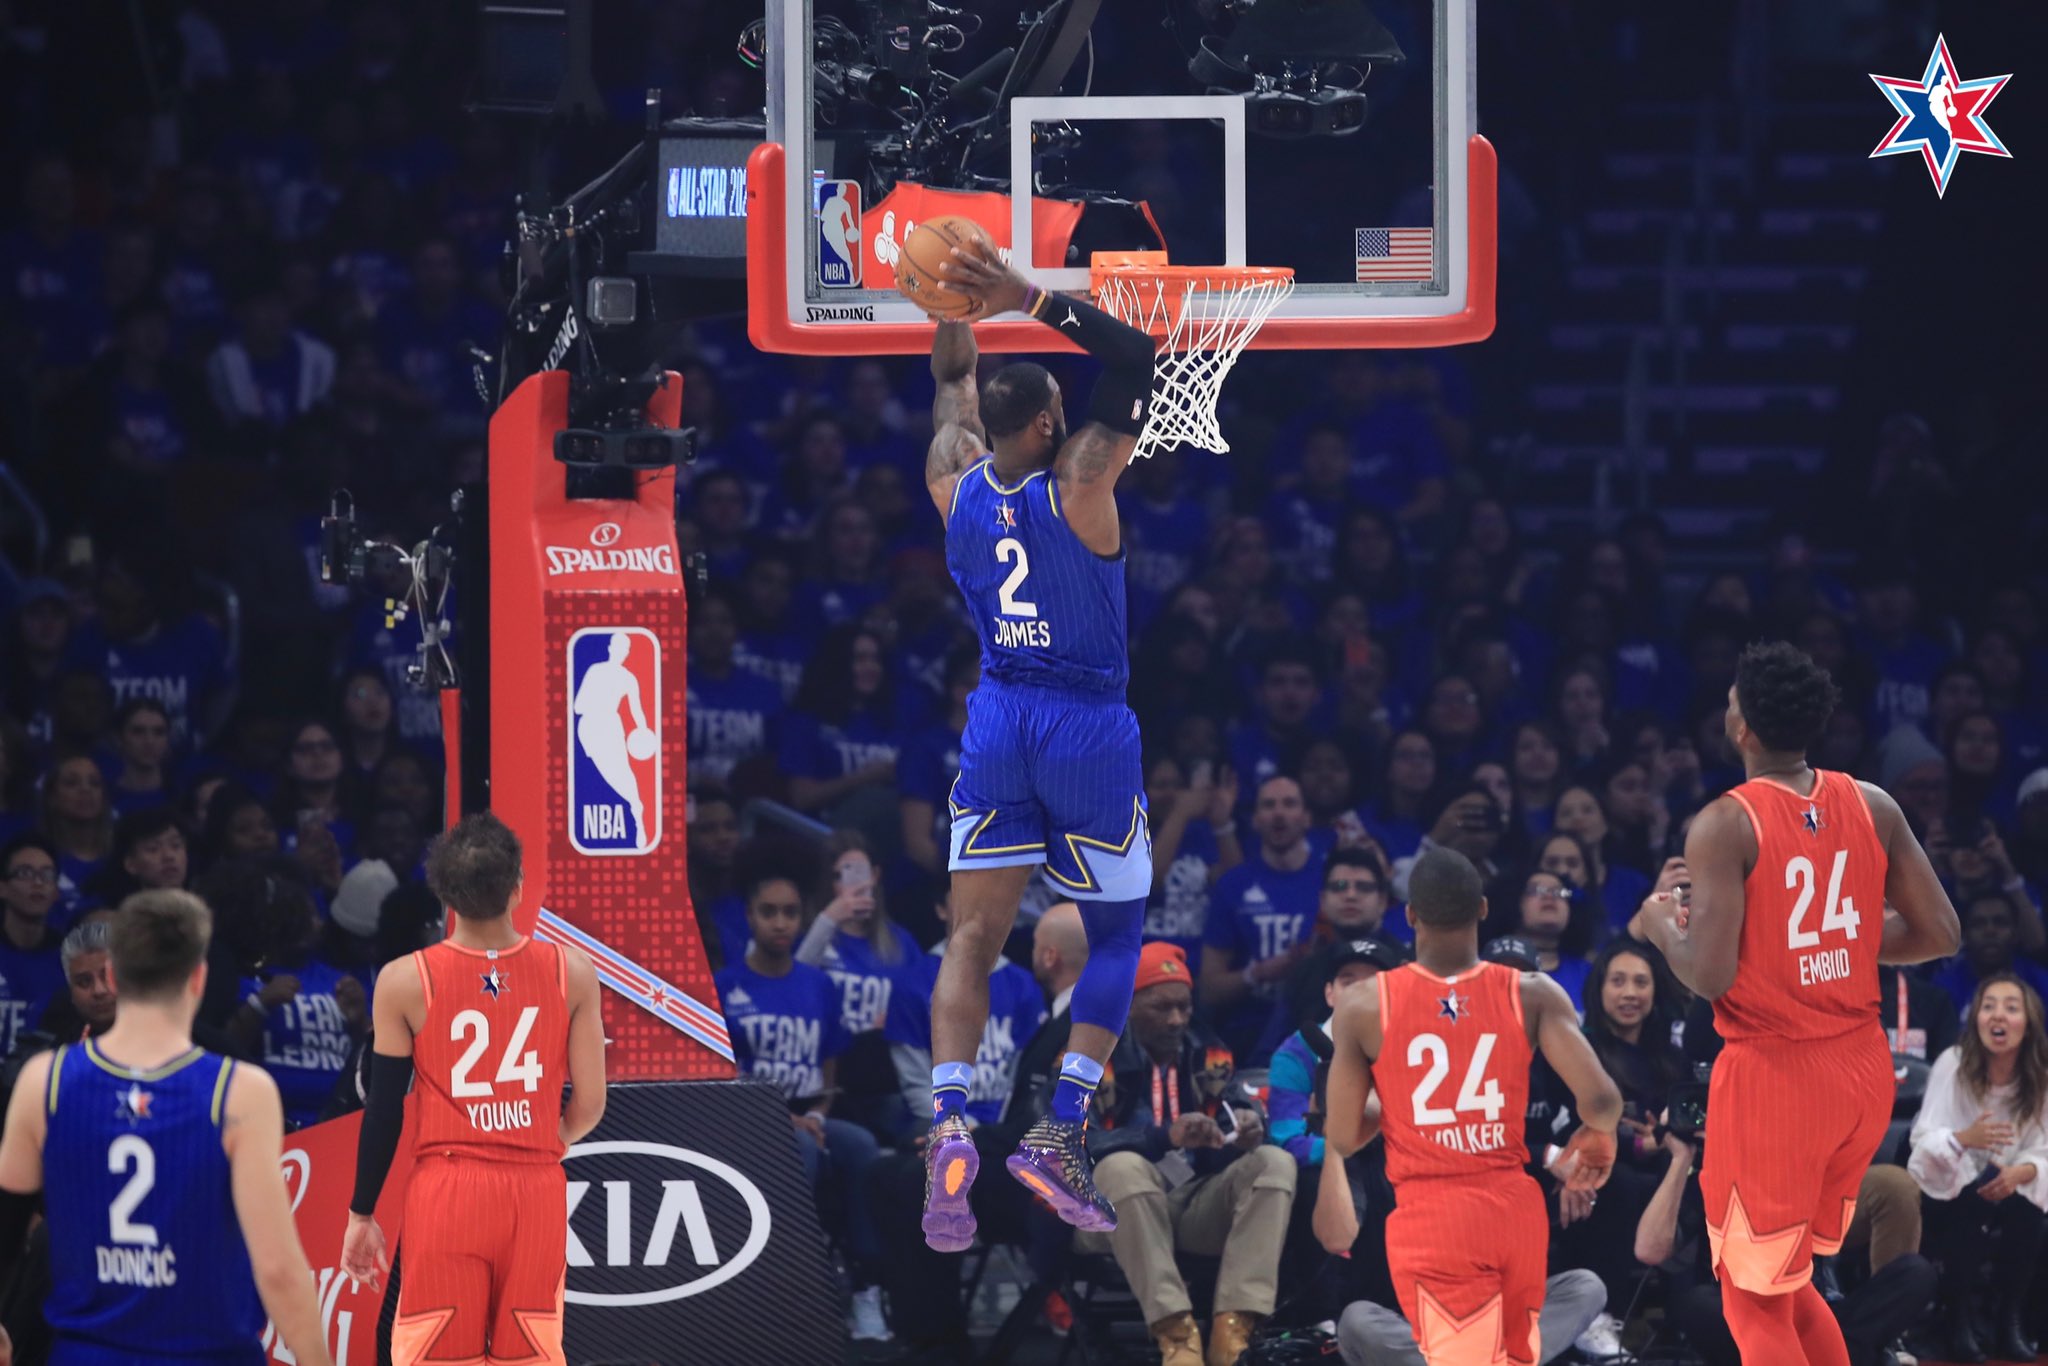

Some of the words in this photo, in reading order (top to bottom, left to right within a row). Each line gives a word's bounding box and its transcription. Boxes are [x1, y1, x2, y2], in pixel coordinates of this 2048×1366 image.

[825, 263, 846, 281] NBA
[806, 306, 875, 322] SPALDING
[545, 544, 677, 576] SPALDING
[995, 537, 1038, 617] 2
[993, 616, 1051, 648] JAMES
[583, 804, 627, 840] NBA
[1785, 849, 1861, 950] 24
[1799, 947, 1850, 986] EMBIID
[450, 1006, 543, 1098] 24
[738, 1013, 821, 1065] TEAM
[1407, 1033, 1505, 1126] 24
[466, 1099, 532, 1132] YOUNG
[108, 1133, 159, 1247] 2
[566, 1180, 720, 1267] KIA
